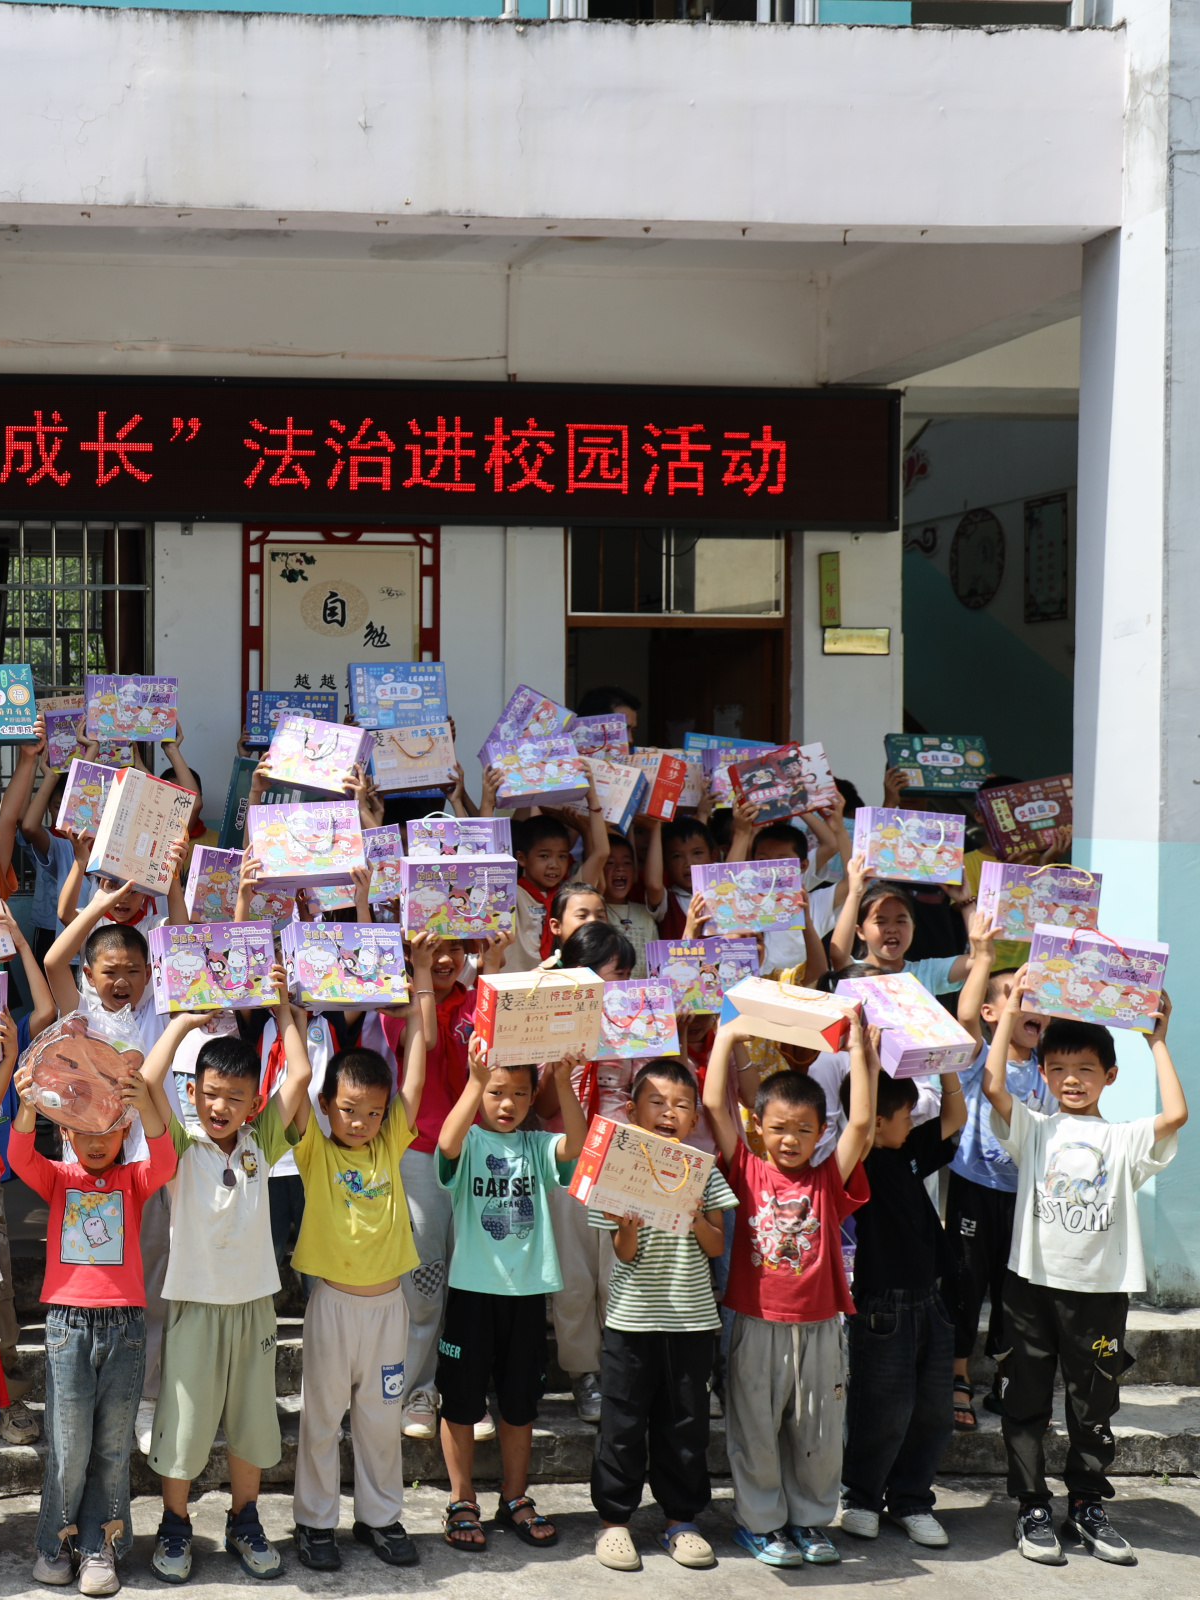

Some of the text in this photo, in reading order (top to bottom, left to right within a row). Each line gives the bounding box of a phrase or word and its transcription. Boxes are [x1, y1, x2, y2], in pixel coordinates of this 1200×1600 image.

[13, 689, 25, 700] 福
[1108, 953, 1160, 972] 惊喜盲盒
[550, 988, 596, 1002] 惊喜盲盒
[661, 1146, 704, 1169] 惊喜盲盒
[472, 1176, 536, 1198] GABSER
